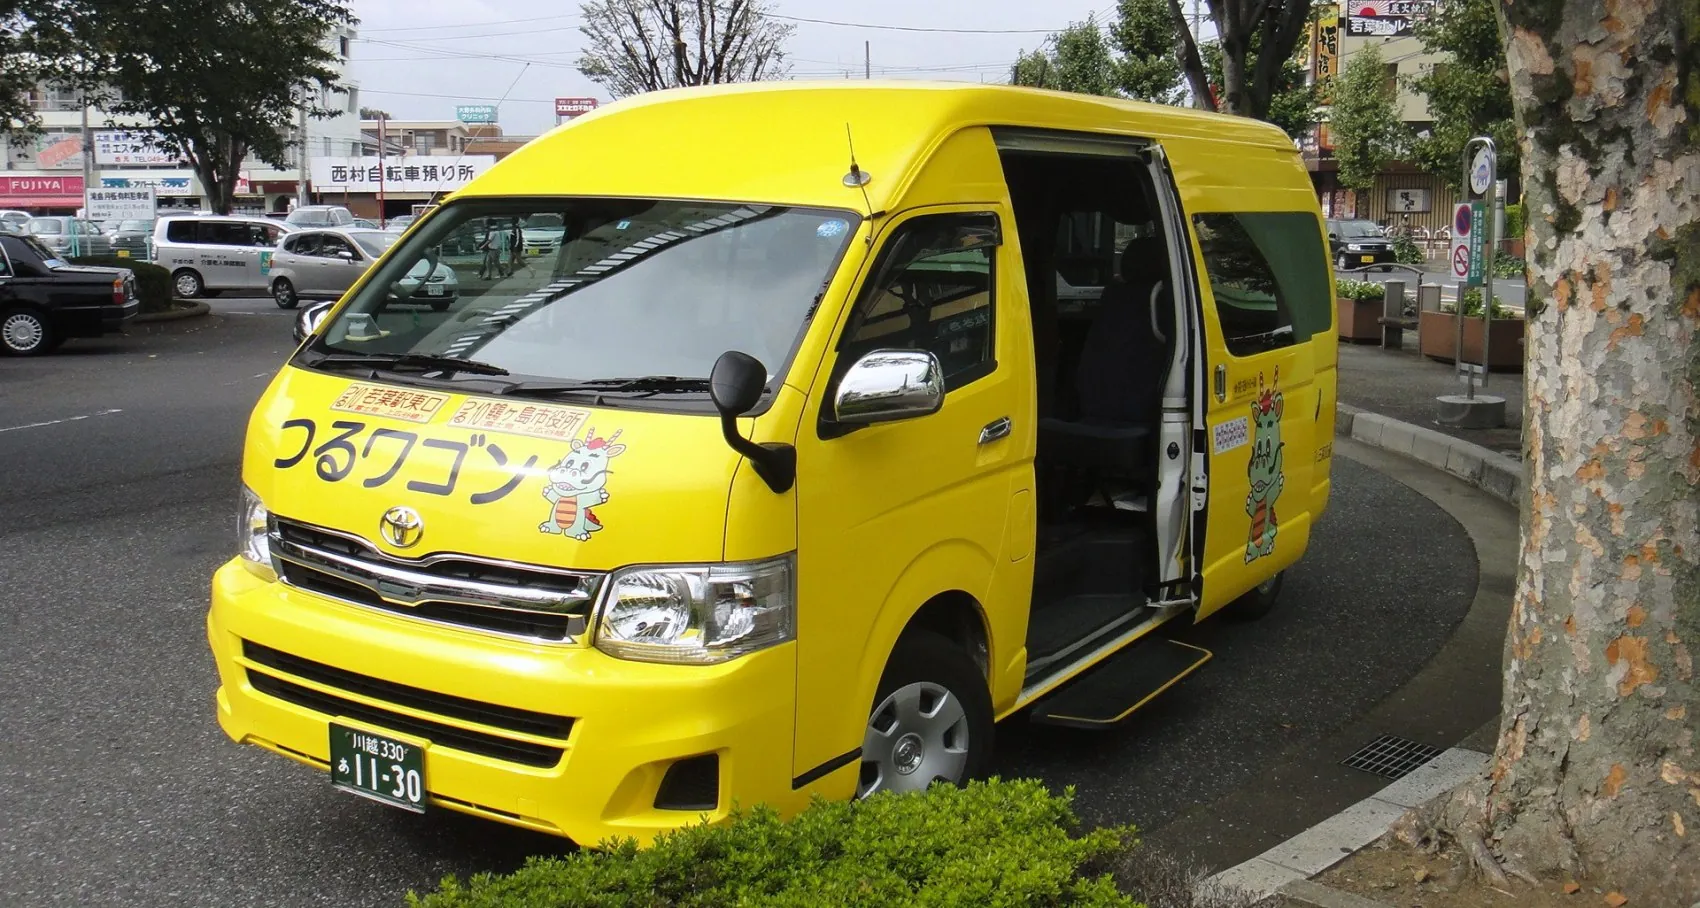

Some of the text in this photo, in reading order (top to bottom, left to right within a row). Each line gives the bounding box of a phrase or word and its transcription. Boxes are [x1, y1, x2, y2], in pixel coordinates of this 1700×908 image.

[11, 181, 61, 190] FUJIYA
[331, 165, 475, 182] 西村自転車預り所
[362, 388, 442, 412] 若葉駅東口
[274, 418, 539, 505] つるワゴン
[352, 733, 404, 762] 川越 330
[338, 753, 421, 803] あ 11-30
